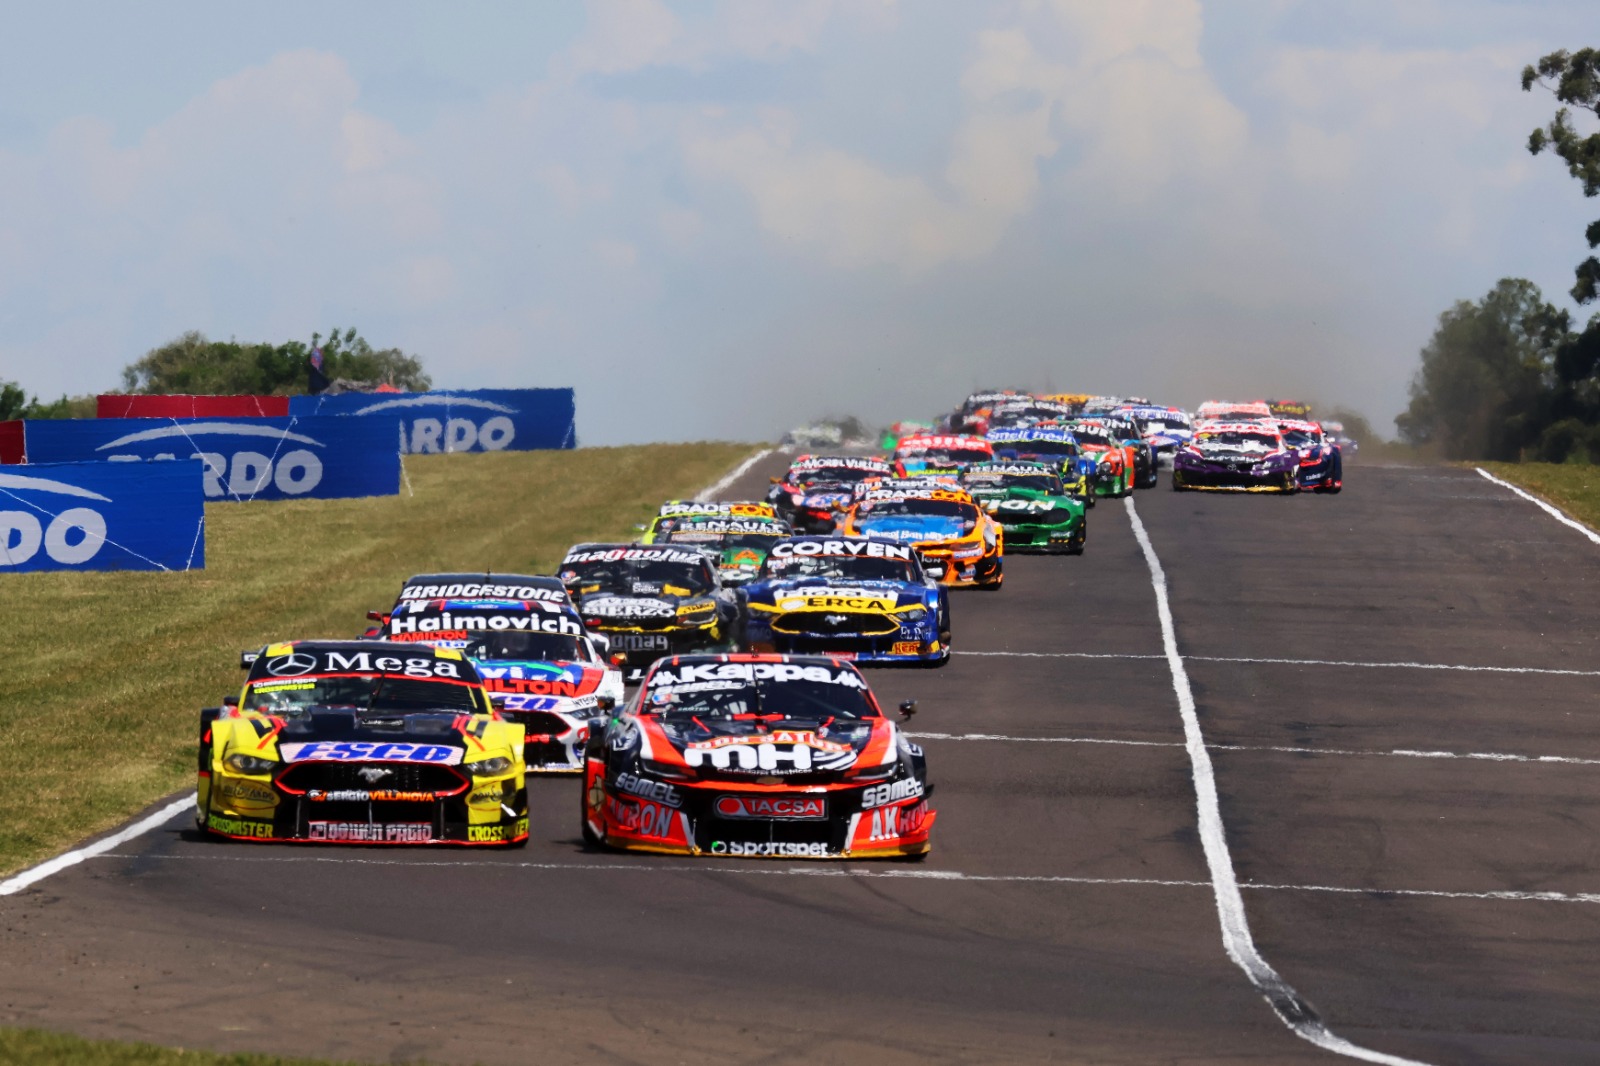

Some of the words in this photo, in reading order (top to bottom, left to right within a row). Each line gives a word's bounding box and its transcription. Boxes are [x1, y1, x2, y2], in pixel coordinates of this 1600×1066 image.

[661, 504, 774, 517] PRADECON
[772, 541, 910, 559] CORVEN
[400, 584, 566, 602] BRIDGESTONE
[391, 613, 580, 635] Haimovich
[389, 630, 467, 642] HAMILTON
[324, 652, 461, 678] Mega
[681, 663, 832, 684] Kappa
[614, 772, 684, 808] samet
[861, 776, 924, 809] samet
[748, 800, 820, 814] TACSA
